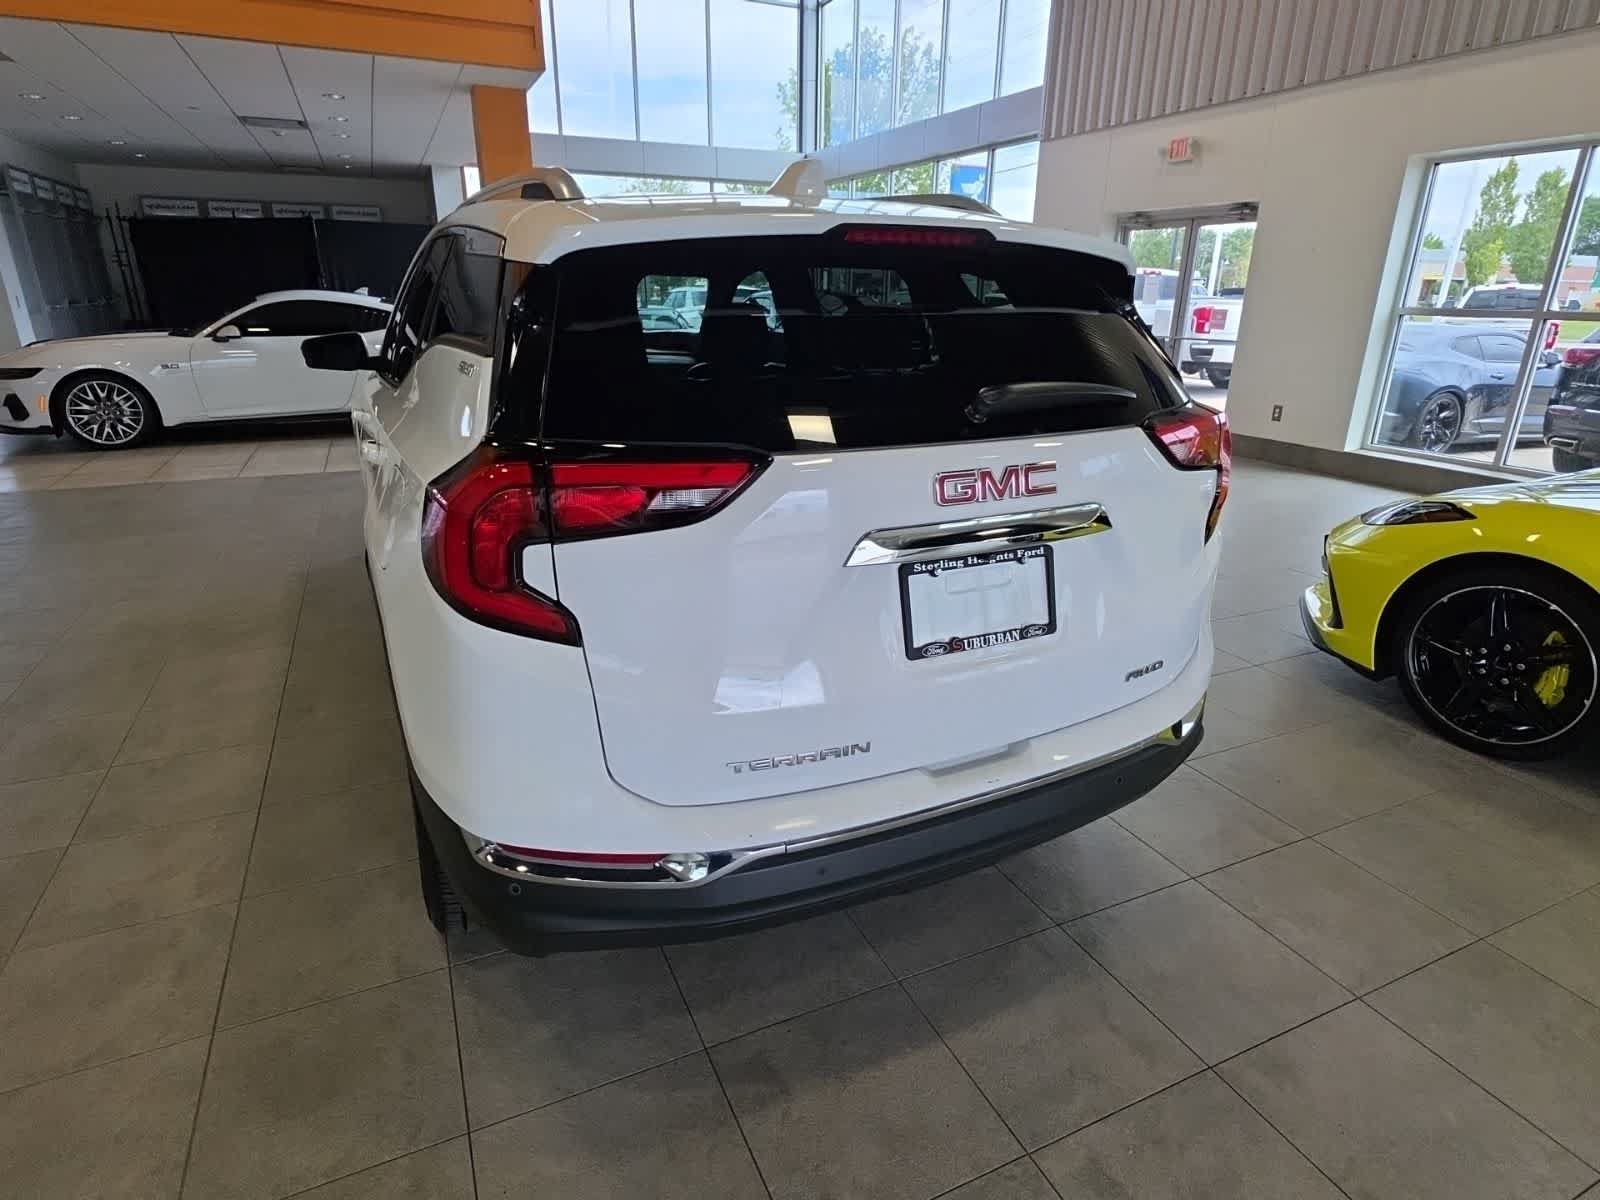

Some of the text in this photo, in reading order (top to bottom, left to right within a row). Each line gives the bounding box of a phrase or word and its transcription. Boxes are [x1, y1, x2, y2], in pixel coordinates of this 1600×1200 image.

[1169, 138, 1189, 159] EXIT
[934, 460, 1057, 507] GMC
[913, 546, 1045, 573] Sterling Hehts Ford
[952, 630, 1020, 653] SUBURBAN
[1026, 626, 1045, 638] Ford
[924, 643, 947, 657] Ford
[1125, 659, 1164, 682] AWD
[725, 741, 872, 774] TERRAIN
